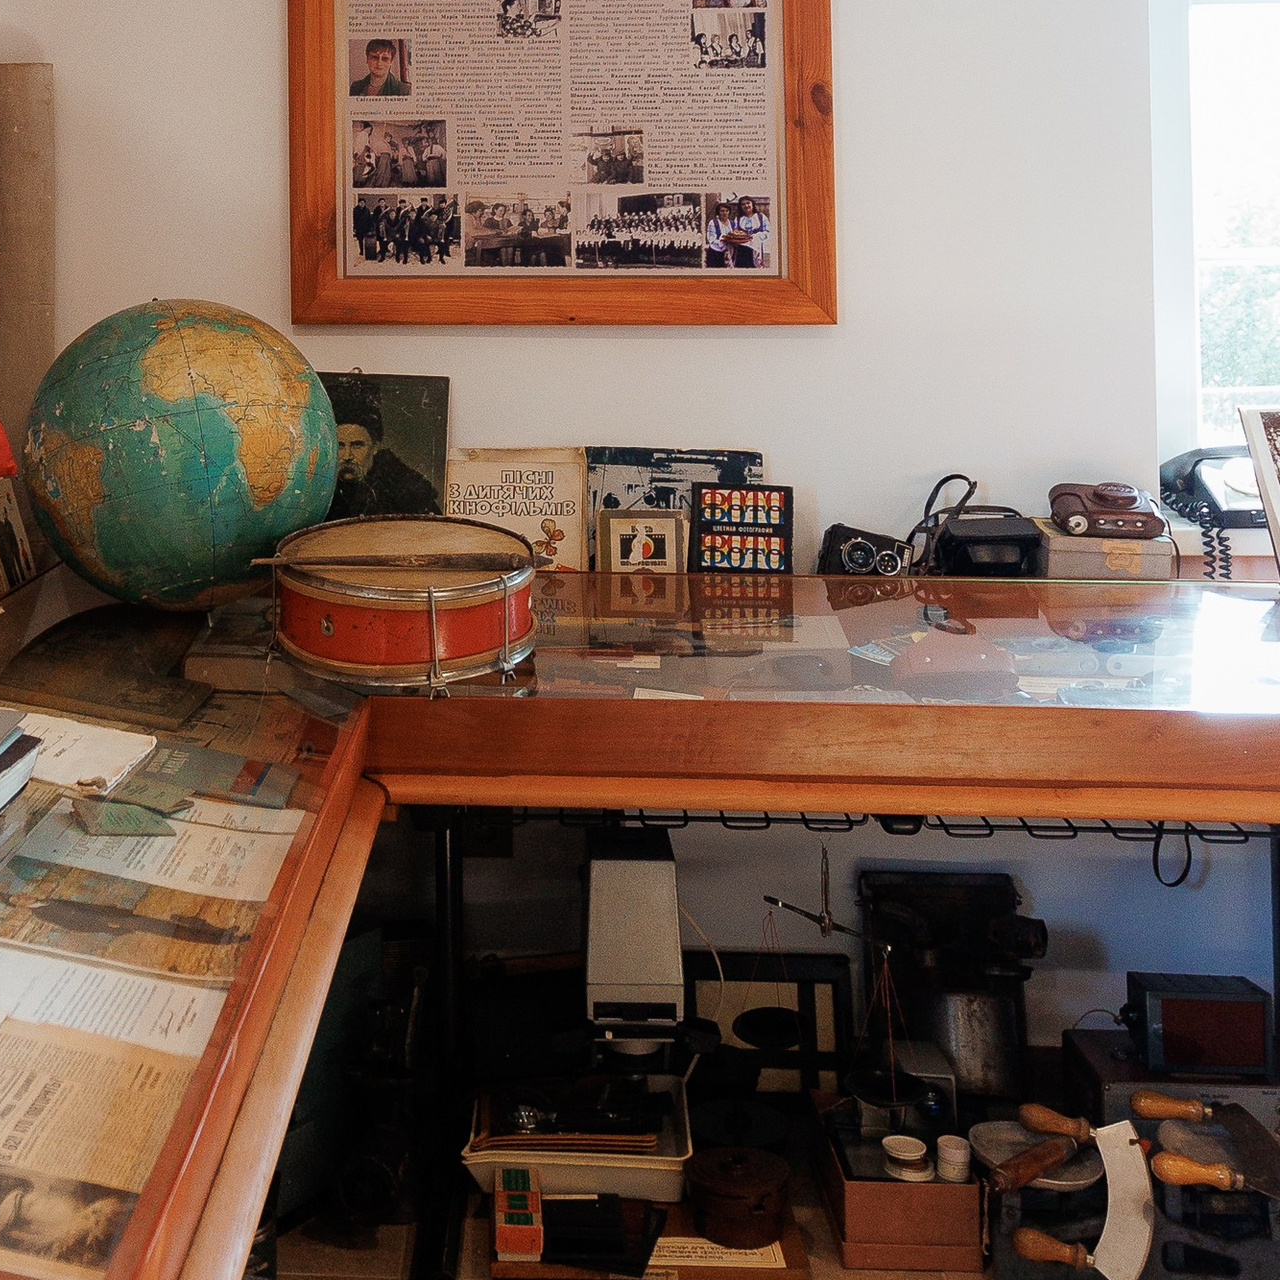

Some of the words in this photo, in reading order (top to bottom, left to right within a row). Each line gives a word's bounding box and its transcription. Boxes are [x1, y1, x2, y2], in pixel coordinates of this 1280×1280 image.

[500, 470, 554, 485] ПІСНІ
[449, 483, 461, 497] З
[463, 484, 554, 500] ДИТЯЧИХ
[448, 500, 576, 517] КІНОФІЛЬМІВ
[712, 524, 737, 532] ЦВЕТНАЯ
[738, 524, 774, 533] ФОТОГРАФИЯ
